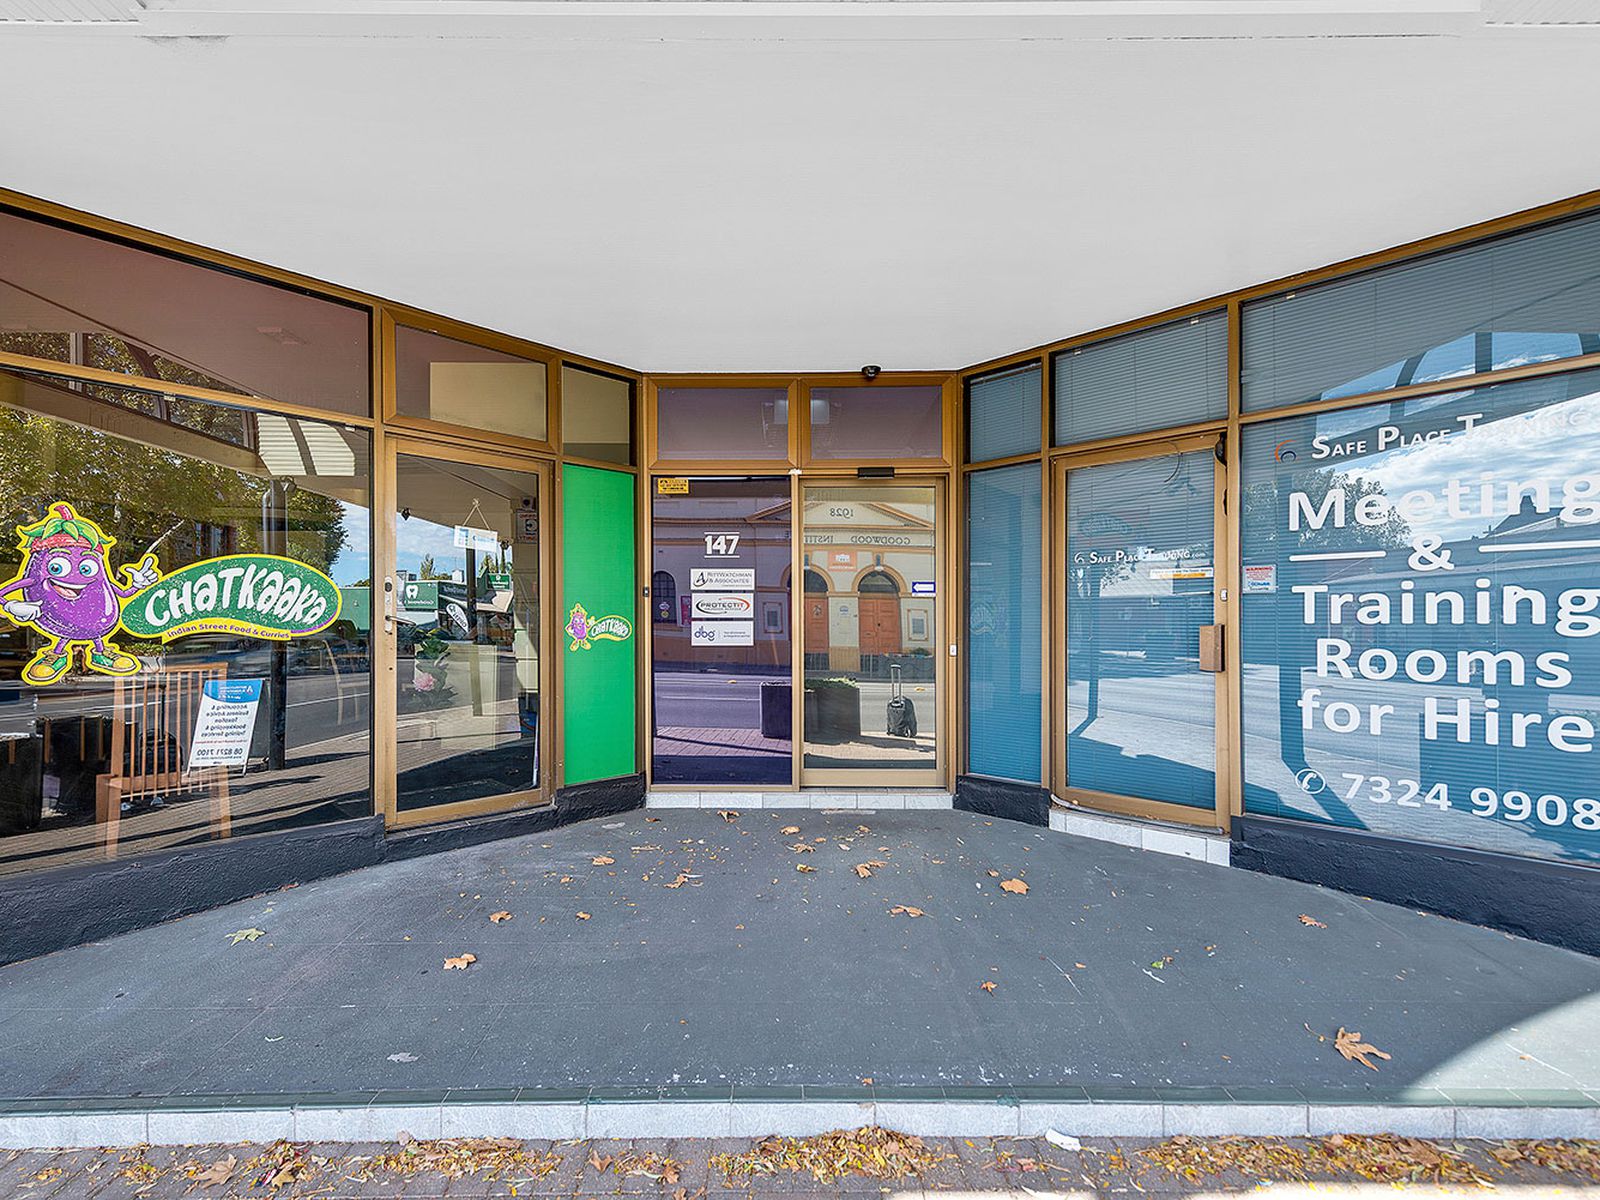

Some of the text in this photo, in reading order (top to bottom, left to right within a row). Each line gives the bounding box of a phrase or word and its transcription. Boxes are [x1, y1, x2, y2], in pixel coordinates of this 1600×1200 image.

[1311, 435, 1366, 460] SAFE
[1377, 425, 1452, 451] PLACE
[1288, 471, 1600, 532] Meeting
[704, 535, 740, 555] 147
[1406, 533, 1455, 571] &
[166, 625, 198, 639] Indian
[198, 623, 228, 631] Street
[229, 625, 251, 634] Food
[259, 630, 290, 639] Curries
[1291, 578, 1600, 638] Training
[1316, 637, 1573, 689] Rooms
[1297, 688, 1596, 753] for Hire
[1341, 773, 1600, 831] 7324 9908
